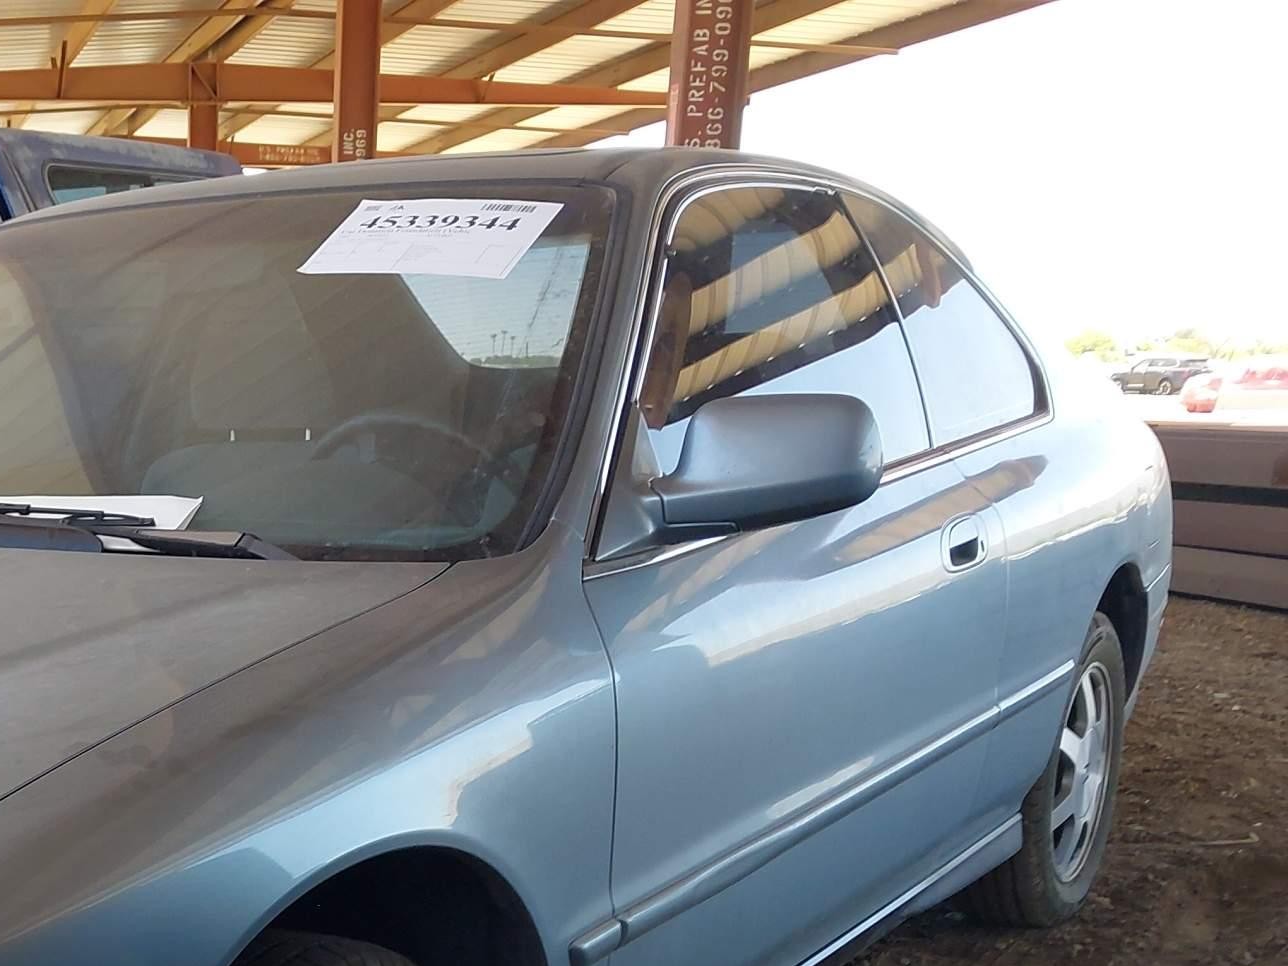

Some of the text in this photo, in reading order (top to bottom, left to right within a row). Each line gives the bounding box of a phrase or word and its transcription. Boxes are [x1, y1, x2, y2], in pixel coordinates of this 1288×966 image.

[687, 28, 710, 116] PREFAB
[705, 0, 733, 149] 866-799-09
[344, 129, 354, 154] INC.
[360, 215, 521, 231] 45339344
